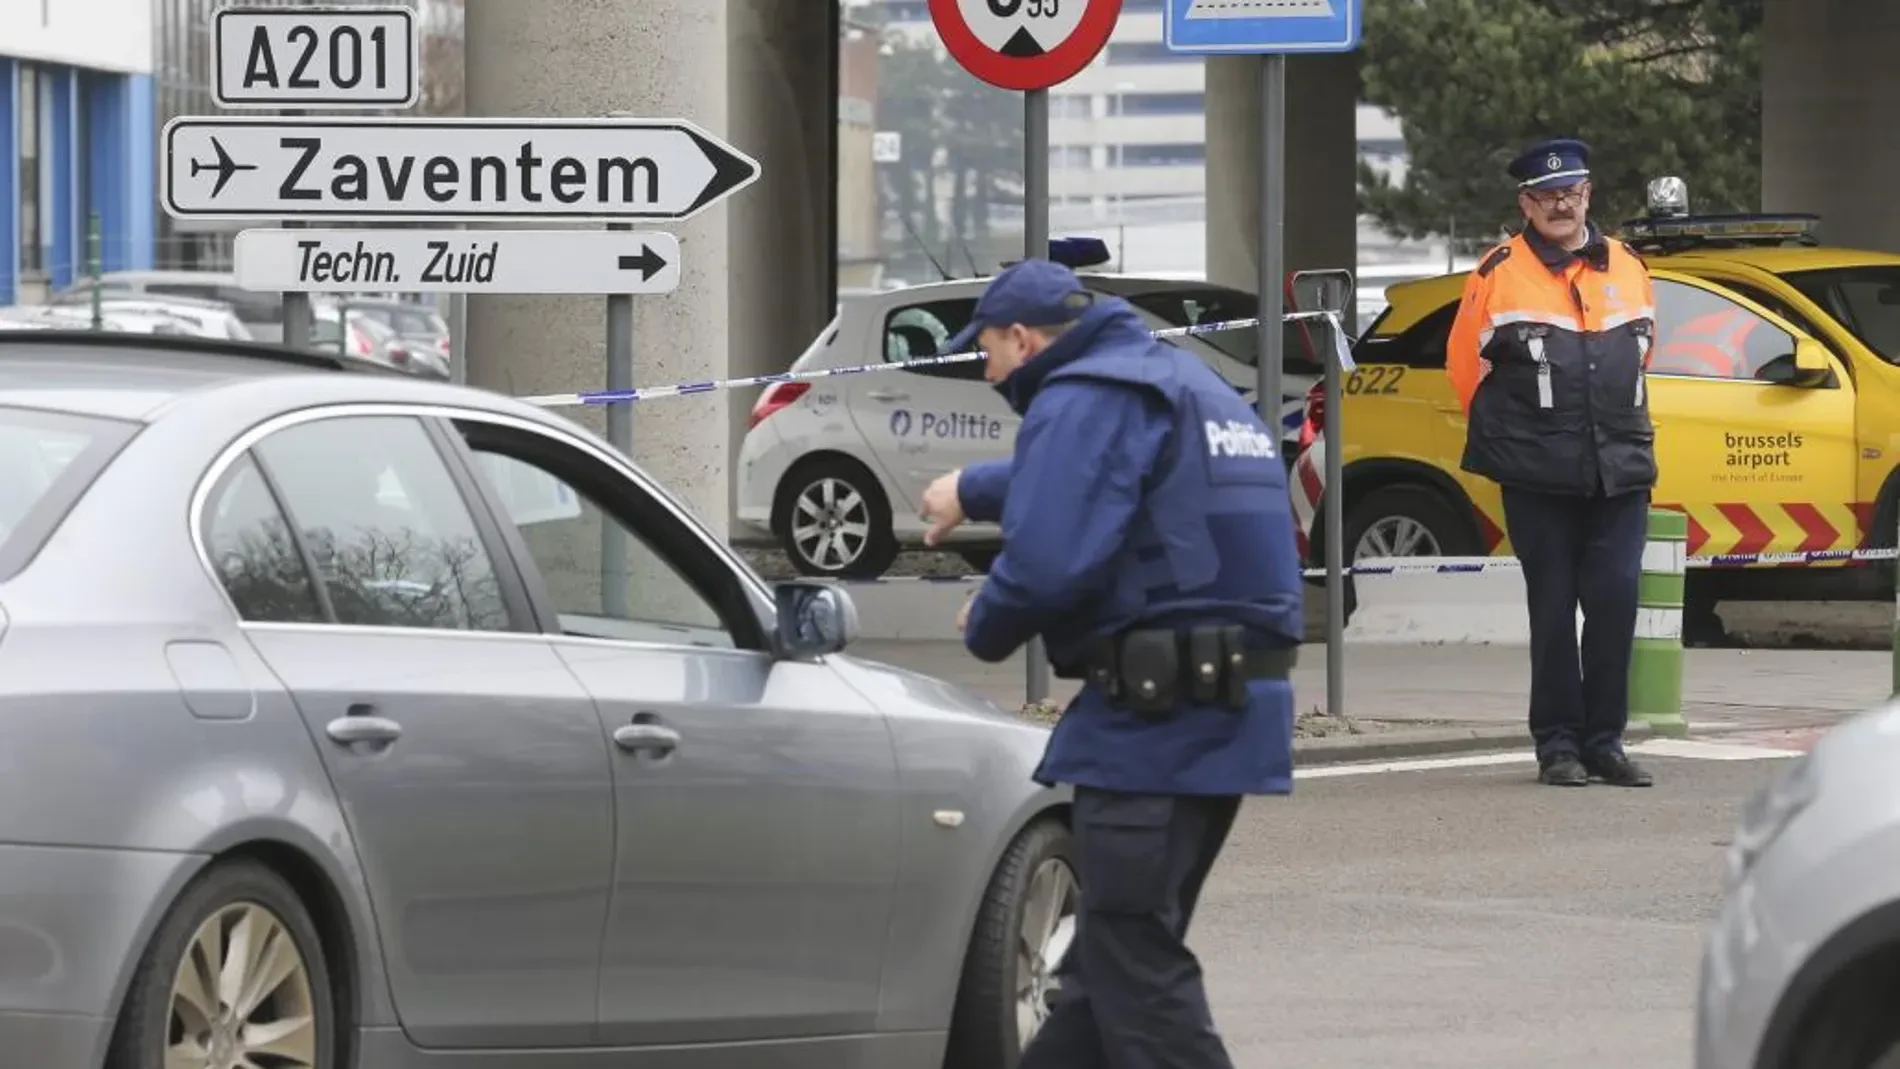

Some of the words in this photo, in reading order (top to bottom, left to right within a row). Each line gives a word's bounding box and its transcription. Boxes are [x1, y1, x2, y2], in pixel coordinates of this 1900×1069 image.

[242, 25, 386, 89] A201
[279, 138, 659, 203] Zaventem
[298, 241, 400, 283] Techn.
[420, 241, 499, 284] Zuid
[921, 412, 1002, 440] Politie
[1204, 420, 1276, 458] Politie
[1725, 432, 1804, 449] brussels
[1726, 450, 1790, 469] airport
